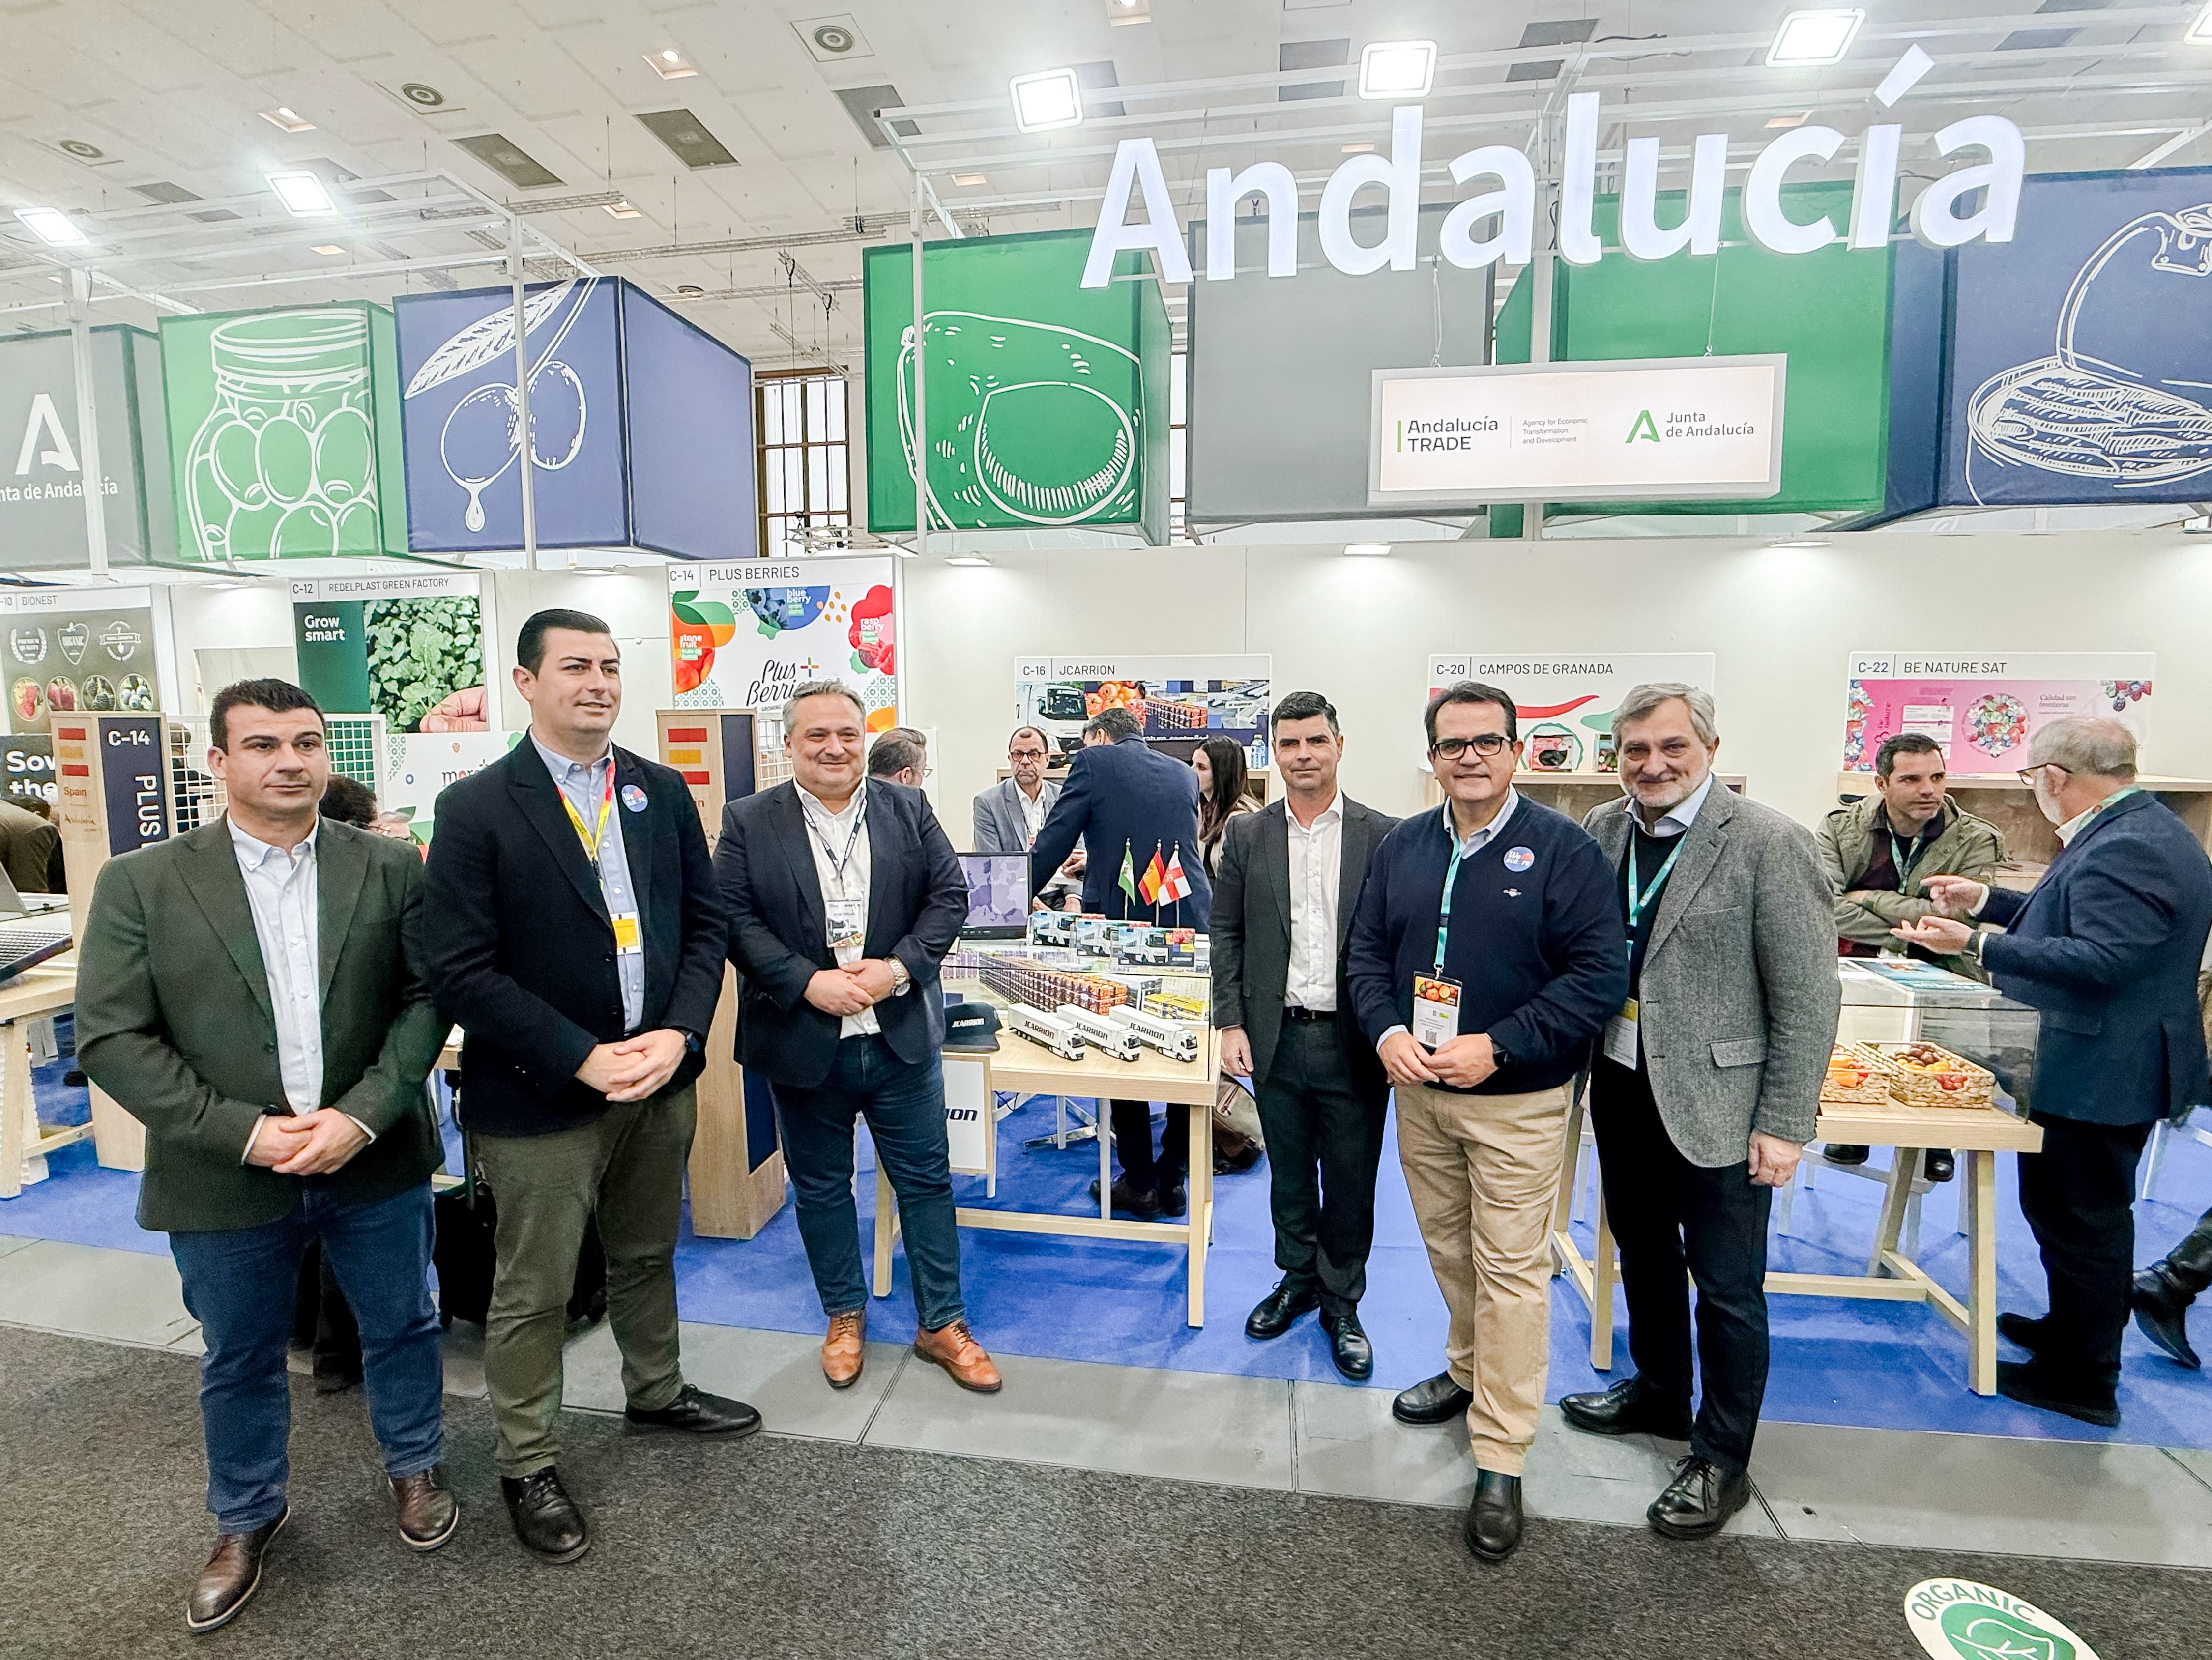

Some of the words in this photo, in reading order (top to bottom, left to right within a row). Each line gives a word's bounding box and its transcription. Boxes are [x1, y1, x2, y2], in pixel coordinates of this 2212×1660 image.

[1079, 44, 2026, 290] Andalucía
[1408, 415, 1498, 434] Andalucía
[1667, 412, 1705, 423] Junta
[1666, 426, 1682, 437] de
[1686, 422, 1754, 437] Andalucía
[1407, 436, 1471, 452] TRADE
[23, 483, 42, 500] de
[670, 570, 694, 581] C-14
[709, 568, 742, 581] PLUS
[746, 566, 800, 579] BERRIES
[293, 583, 313, 594] C-12
[329, 581, 380, 592] REDELPLAST
[383, 580, 410, 589] GREEN
[412, 578, 449, 588] FACTORY
[22, 595, 58, 606] BIONEST
[786, 595, 811, 604] berry
[304, 615, 340, 629] Grow
[860, 623, 885, 633] berry
[305, 628, 345, 642] smart
[762, 659, 796, 683] Plus
[1023, 666, 1046, 676] C-16
[1059, 665, 1115, 676] JCARRION
[1437, 664, 1464, 675] C-20
[1479, 664, 1530, 674] CAMPOS
[1534, 664, 1550, 674] DE
[1553, 663, 1613, 675] GRANADA
[1858, 662, 1888, 673] C-22
[1904, 662, 1921, 673] BE
[1925, 662, 1979, 673] NATURE
[1981, 662, 2007, 673] SAT
[746, 679, 796, 706] Berri
[108, 730, 150, 746] C-14
[64, 786, 87, 797] Spain
[135, 775, 162, 836] PLUS
[1024, 1020, 1055, 1039] JCARRION
[1075, 1022, 1108, 1041] JCARRION
[1130, 1022, 1165, 1041] JCARRION
[1912, 1583, 2036, 1621] ORGANIC
